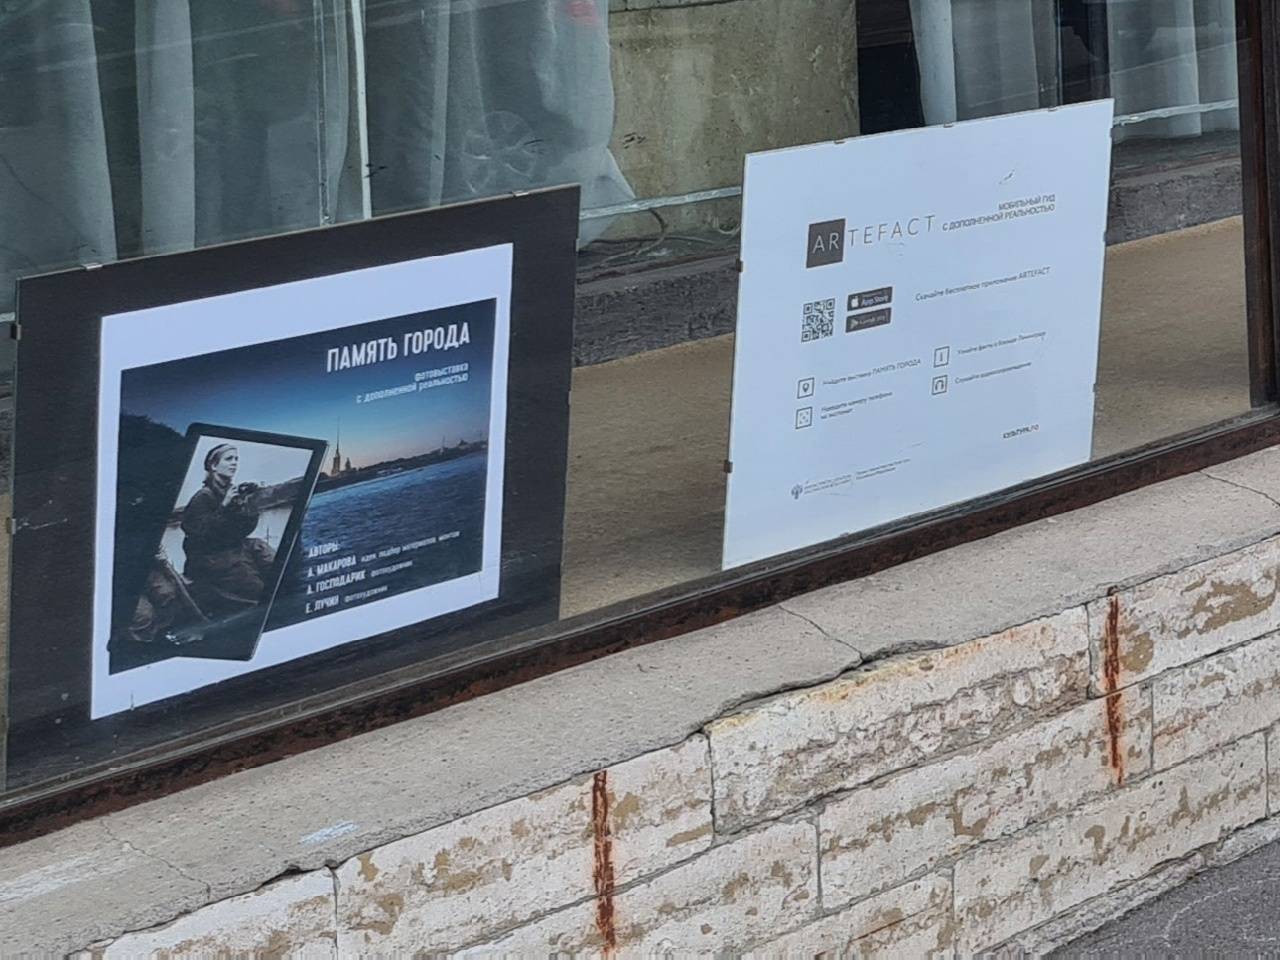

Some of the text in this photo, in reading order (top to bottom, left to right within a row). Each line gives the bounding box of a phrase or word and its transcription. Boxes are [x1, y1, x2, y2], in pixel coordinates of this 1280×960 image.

[1004, 203, 1056, 220] РЕАЛЬНОСТЬЮ
[812, 214, 936, 255] ARTEFACT
[326, 322, 471, 373] ПАМЯТЬ ГОРОДА
[316, 555, 356, 576] МАКАРОВА
